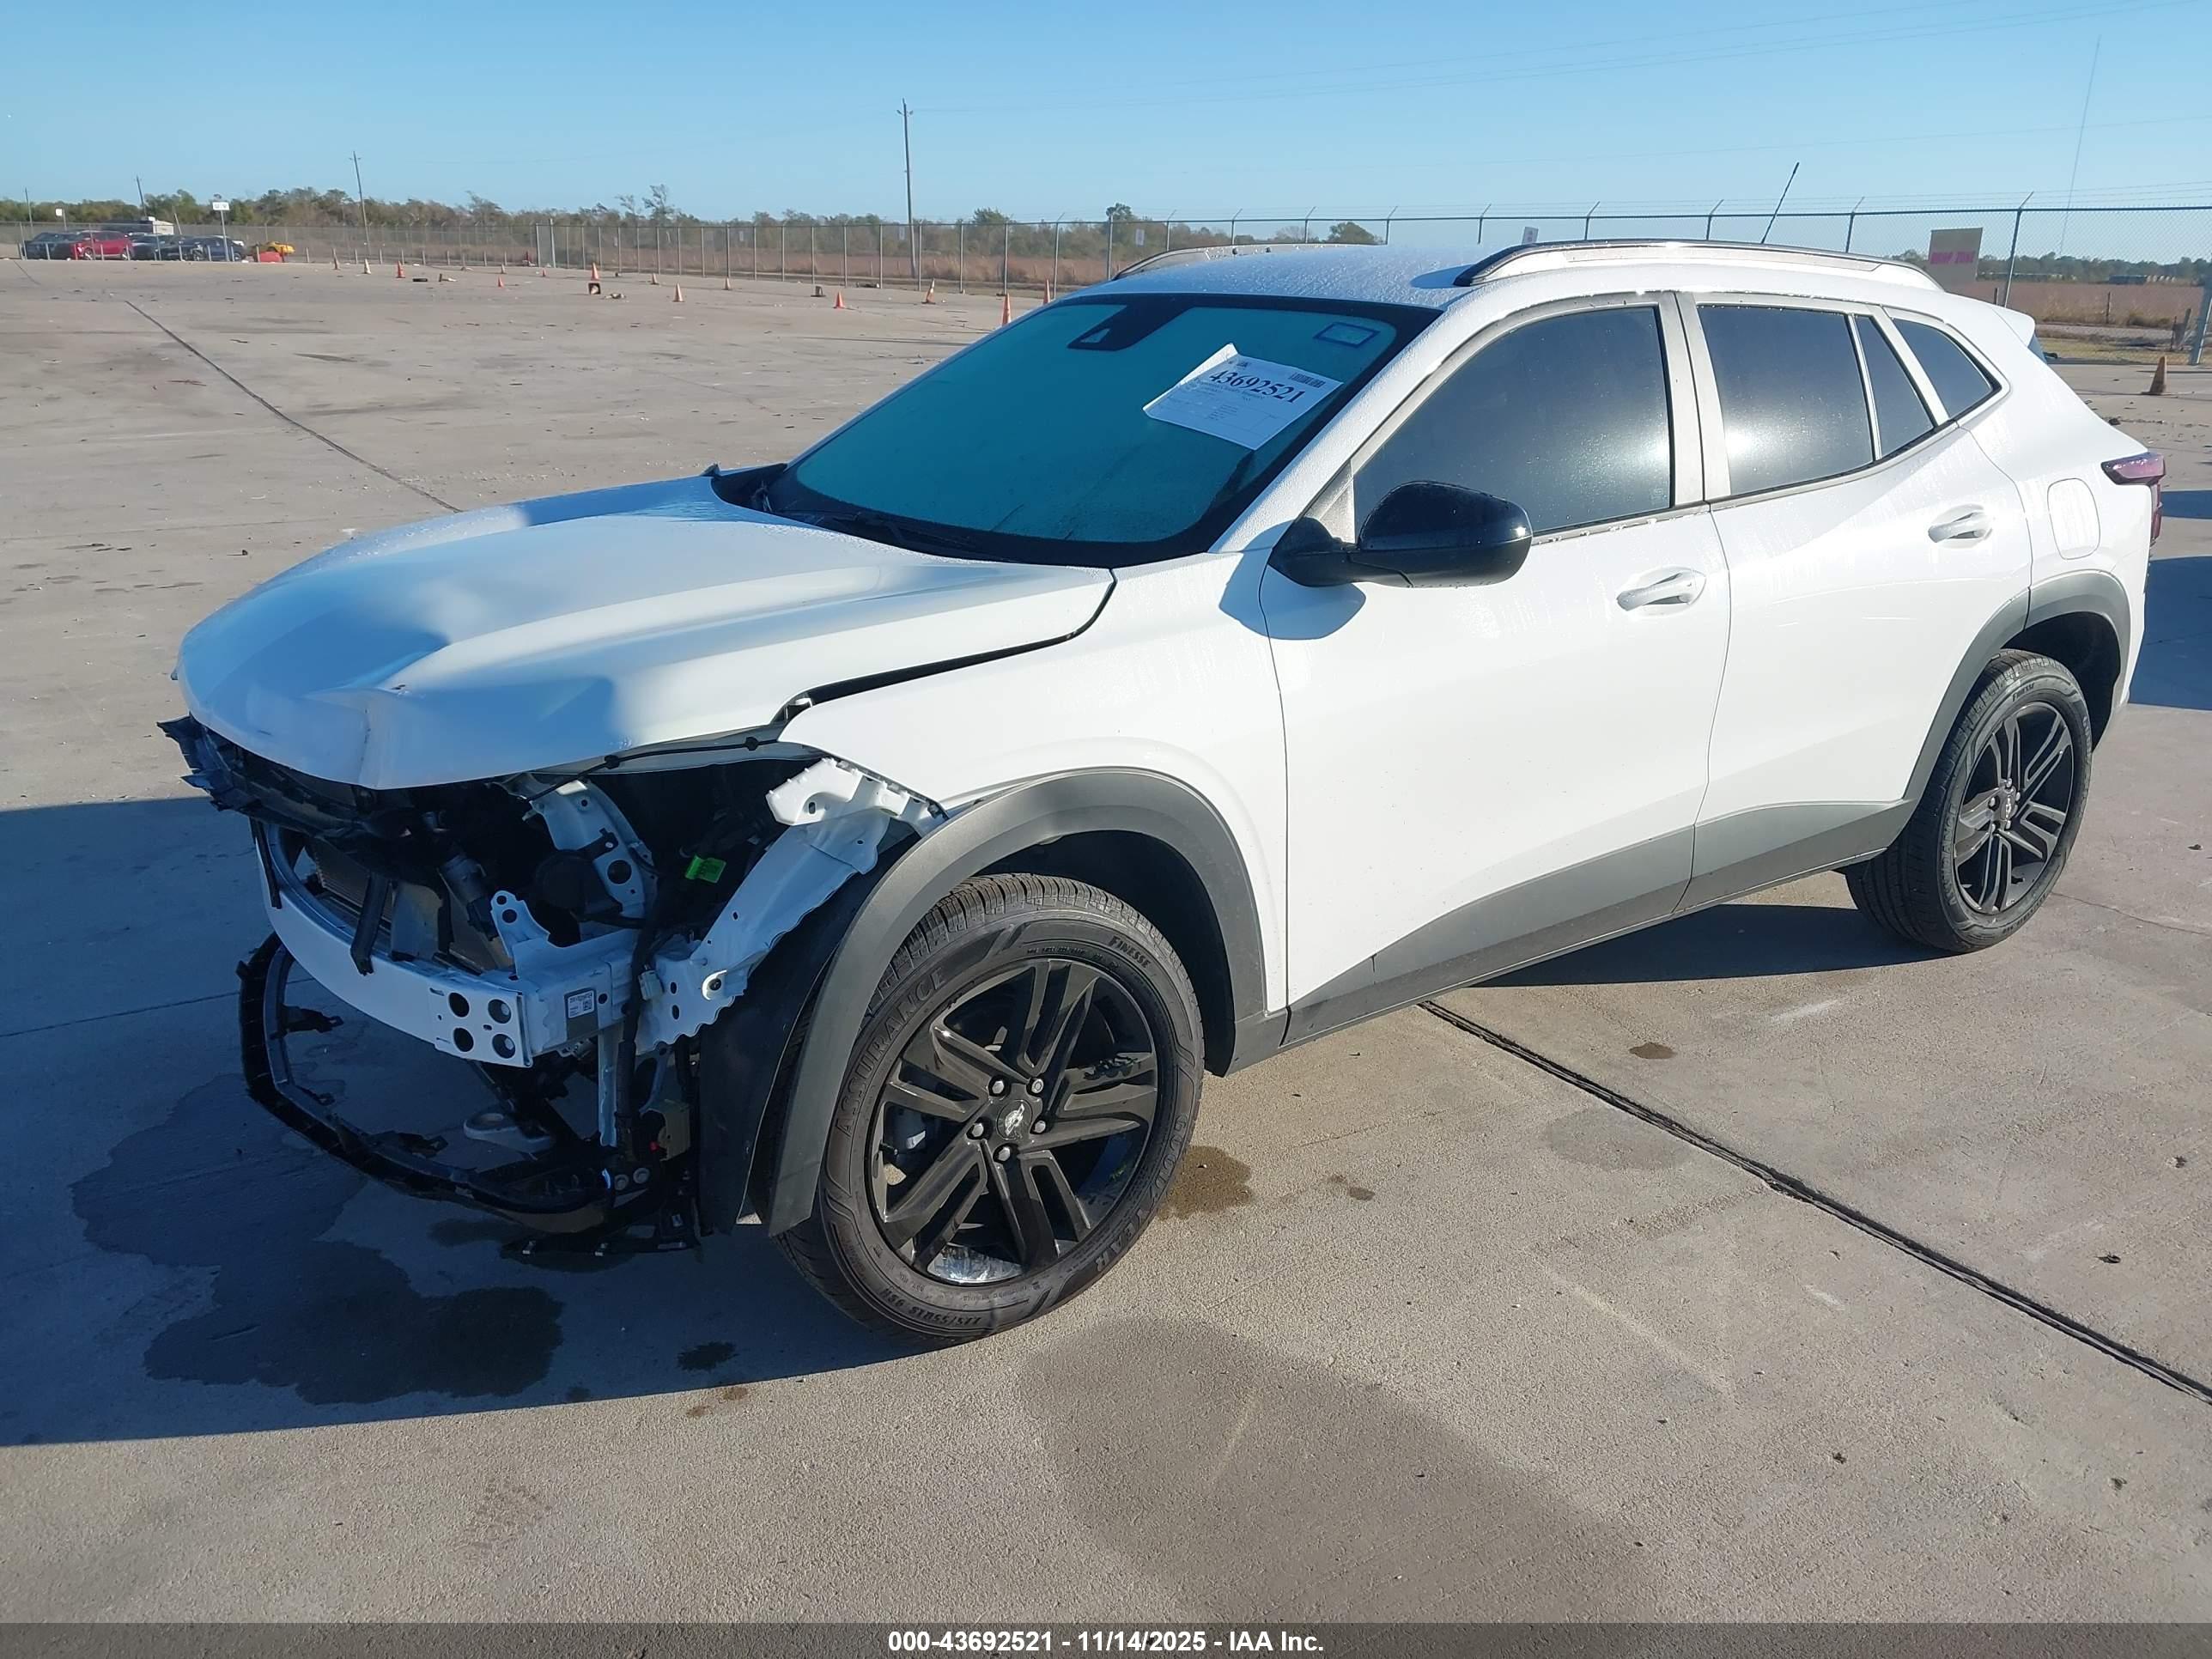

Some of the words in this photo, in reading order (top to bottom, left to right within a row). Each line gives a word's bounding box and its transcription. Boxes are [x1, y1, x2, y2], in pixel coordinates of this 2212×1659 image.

[1209, 370, 1306, 404] 43692521
[1108, 935, 1152, 969] FINESSE
[834, 966, 947, 1138] ASSURANCE
[1095, 1113, 1188, 1273] GOODYEAR
